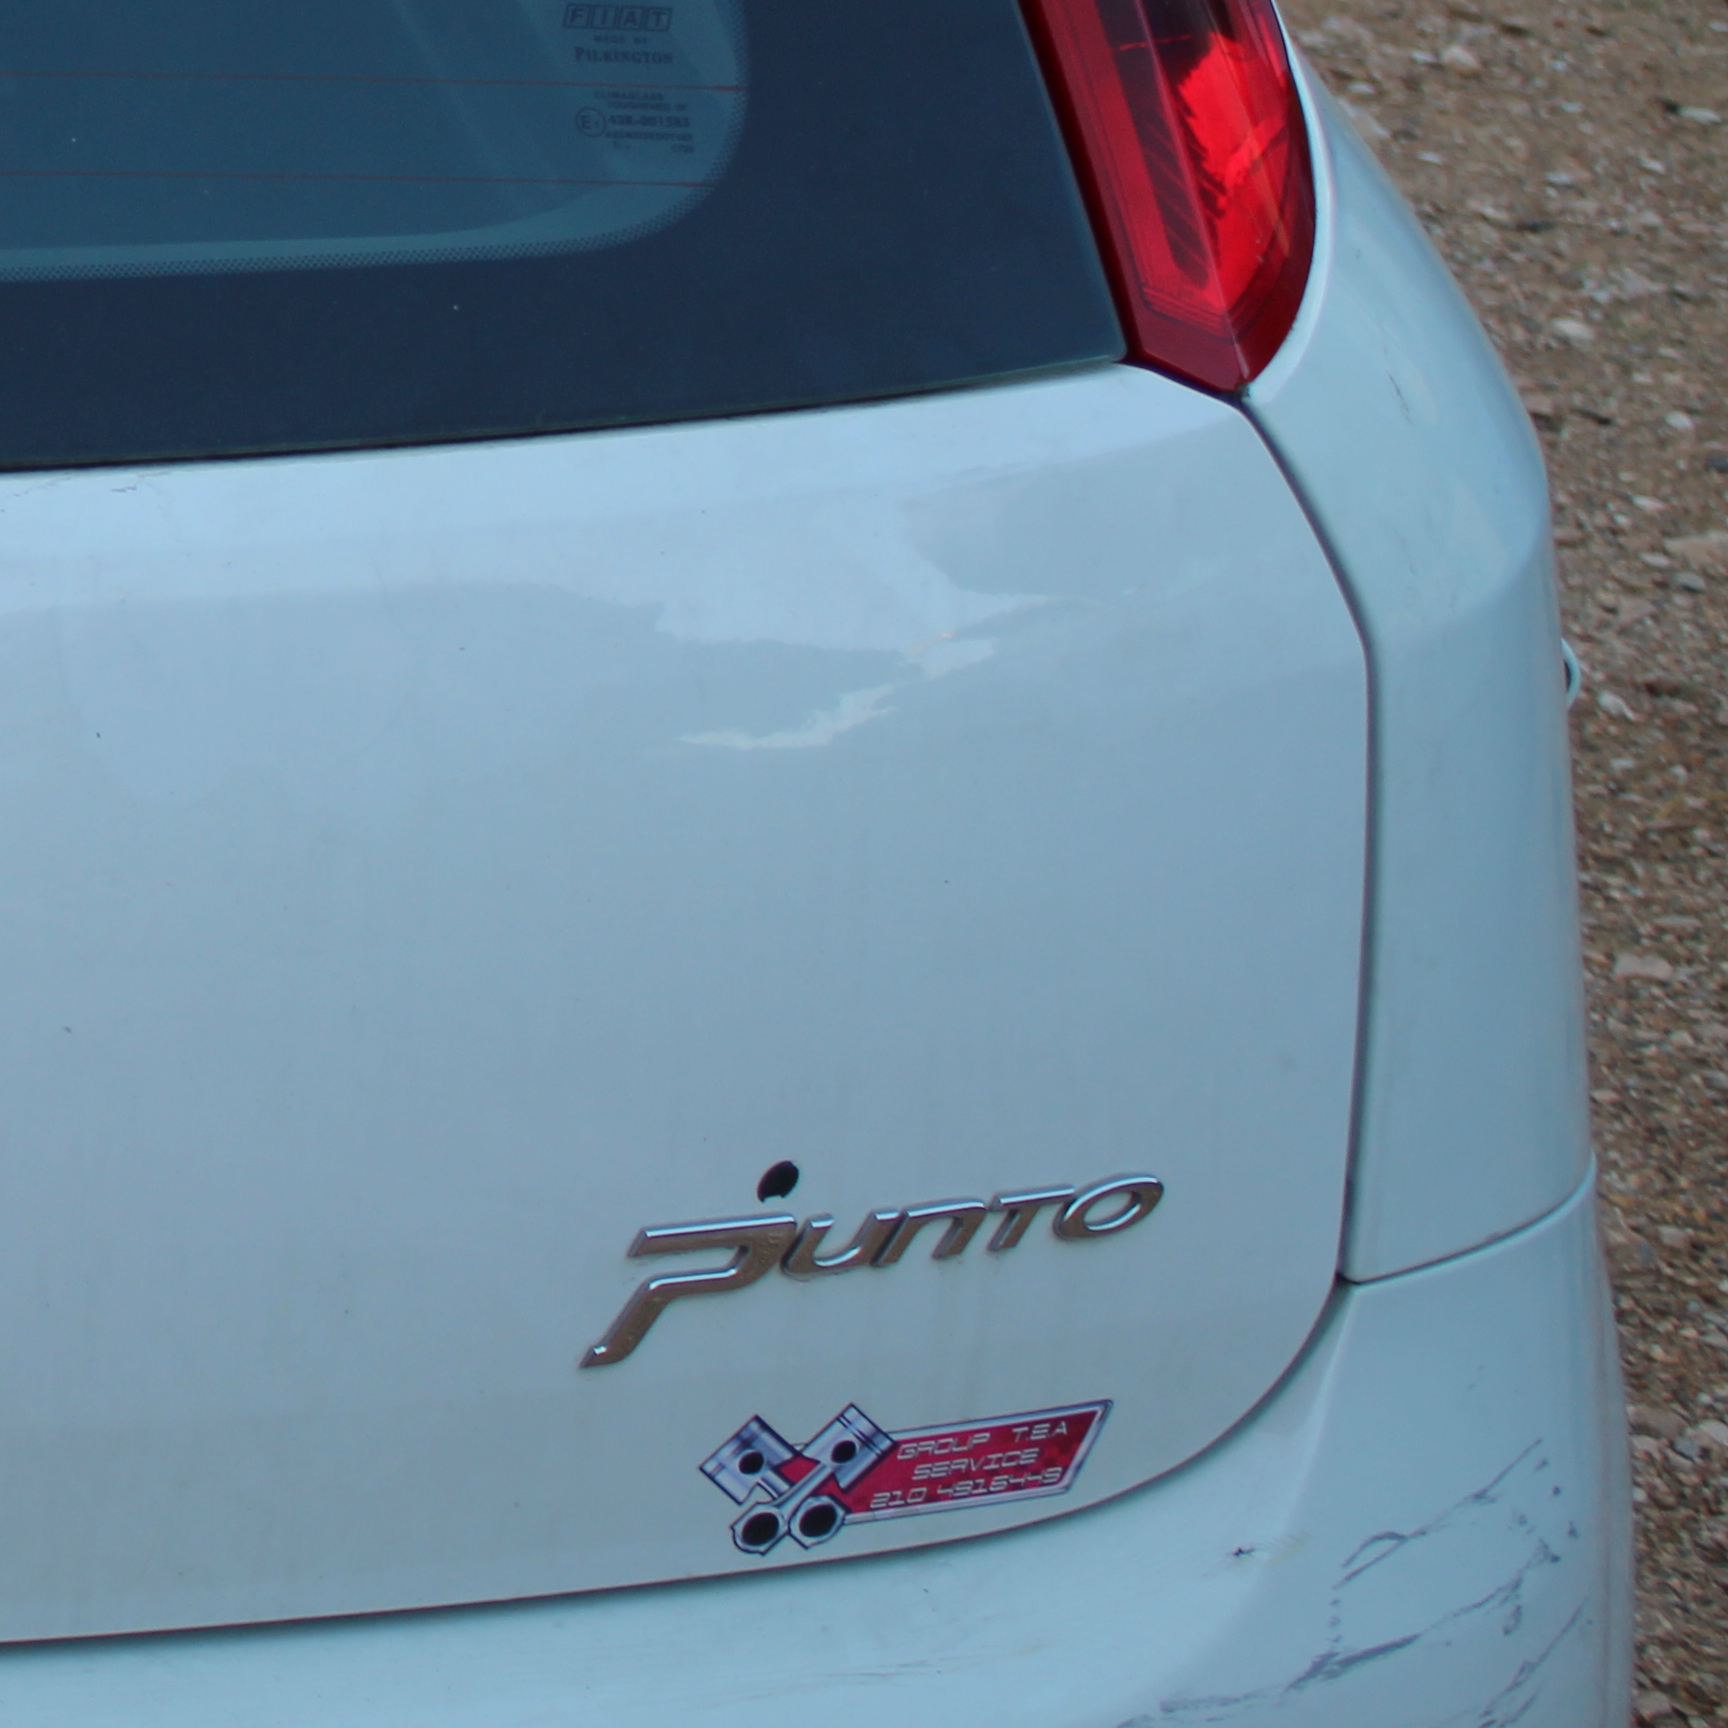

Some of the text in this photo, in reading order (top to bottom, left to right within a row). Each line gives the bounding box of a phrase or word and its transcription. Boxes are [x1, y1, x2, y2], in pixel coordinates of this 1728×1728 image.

[567, 6, 668, 28] FIAT
[897, 1433, 990, 1460] GROUP
[912, 1448, 1039, 1480] SERVICE
[870, 1487, 928, 1509] 210
